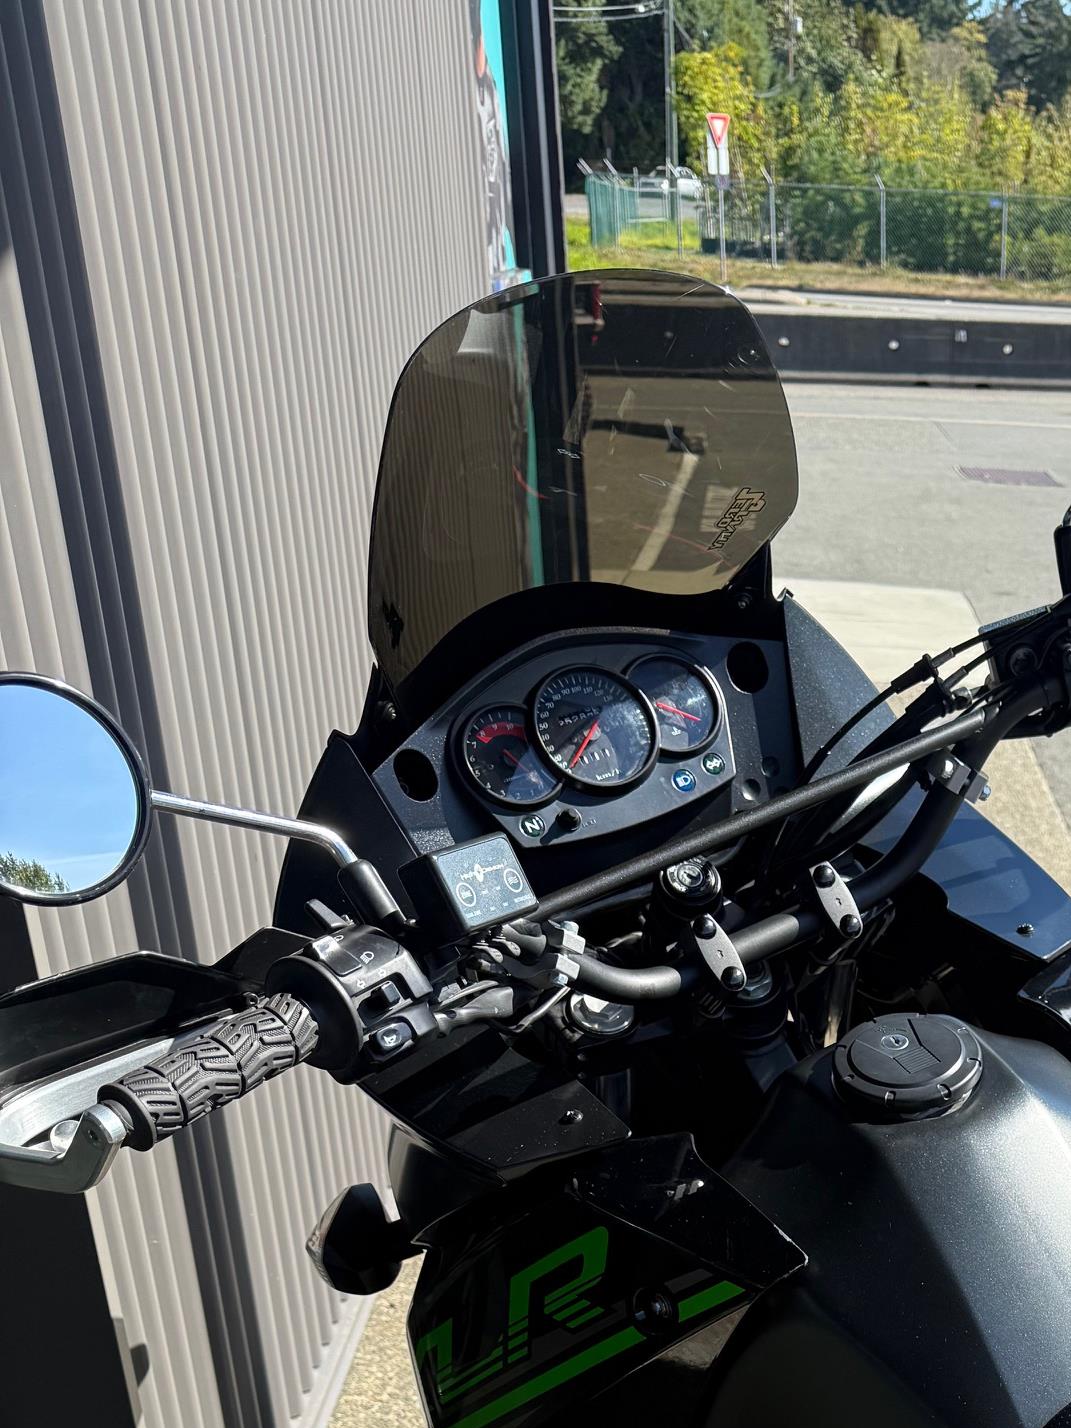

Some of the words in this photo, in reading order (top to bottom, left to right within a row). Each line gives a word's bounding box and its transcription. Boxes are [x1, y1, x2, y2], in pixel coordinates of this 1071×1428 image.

[545, 701, 555, 709] 70
[540, 711, 550, 719] 60
[539, 722, 549, 730] 50
[472, 741, 477, 749] 7
[524, 816, 540, 833] N
[415, 1225, 609, 1406] LR
